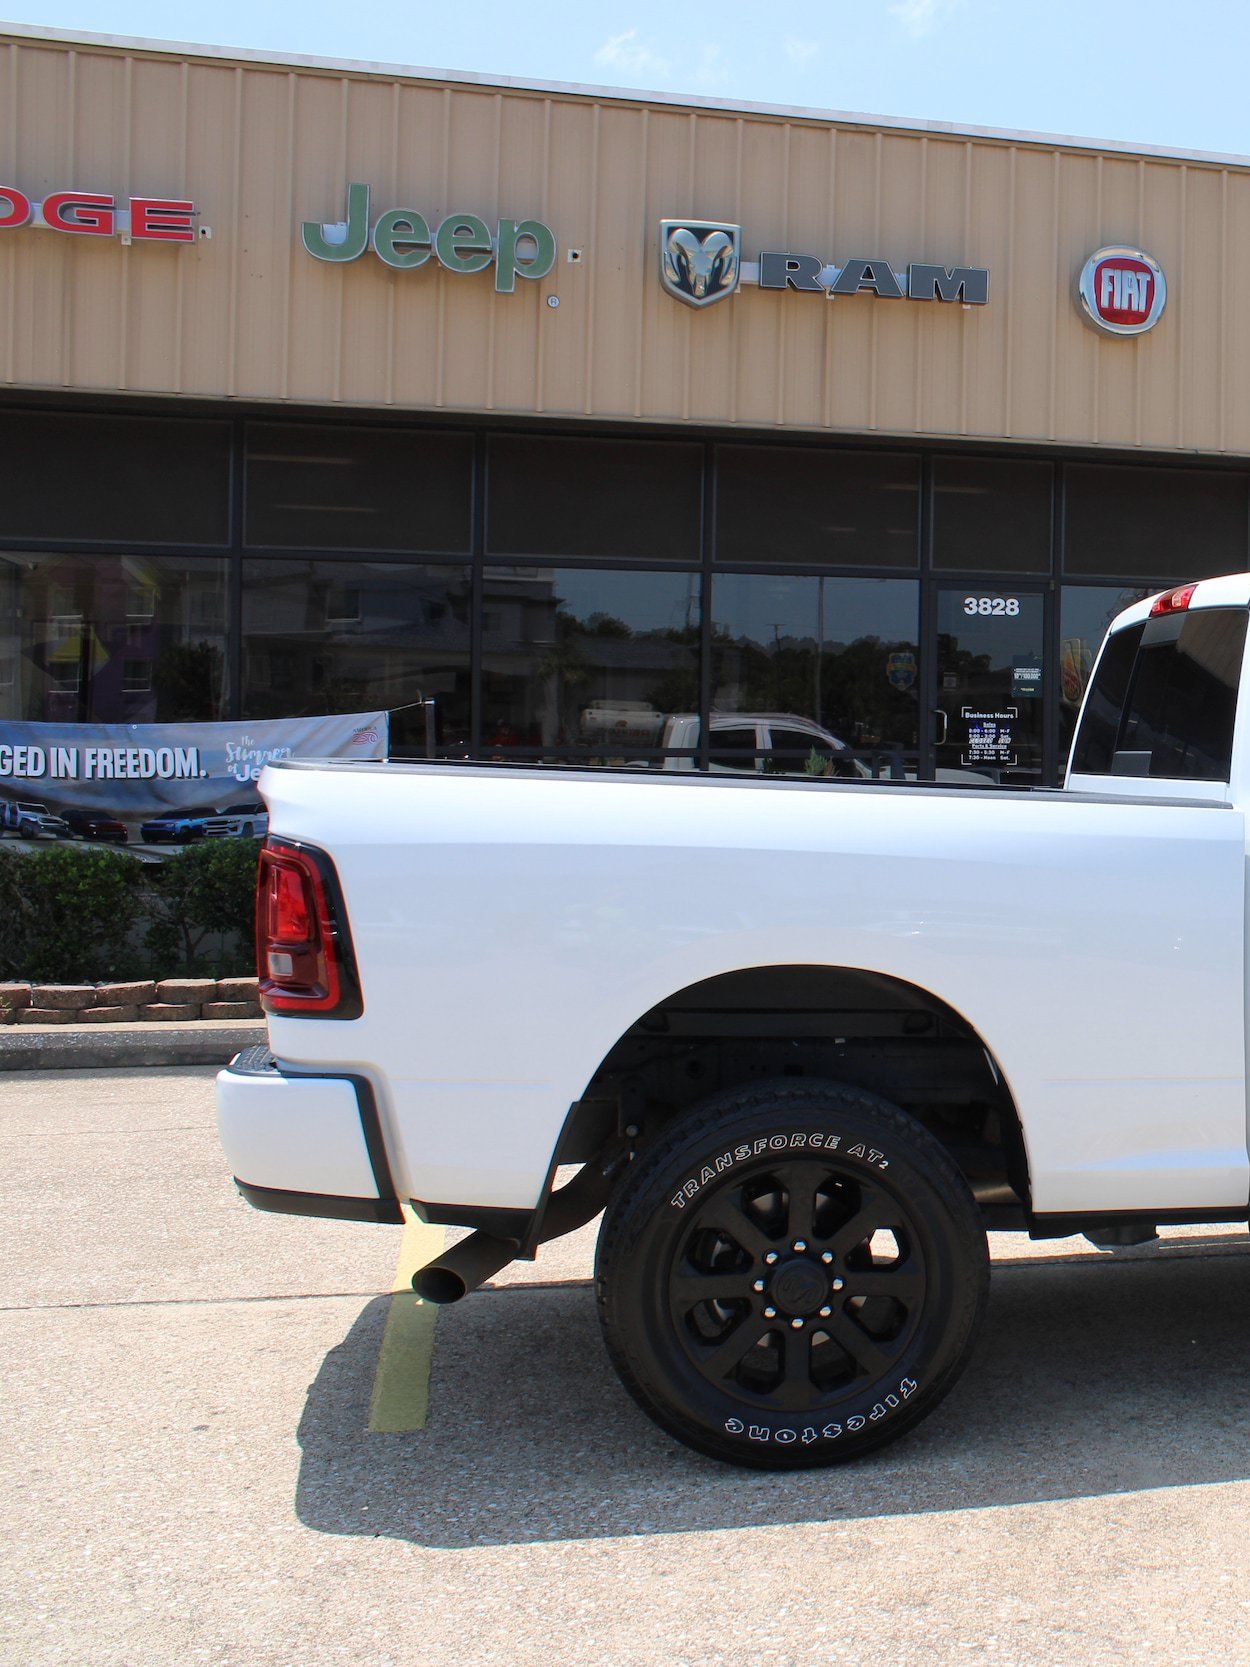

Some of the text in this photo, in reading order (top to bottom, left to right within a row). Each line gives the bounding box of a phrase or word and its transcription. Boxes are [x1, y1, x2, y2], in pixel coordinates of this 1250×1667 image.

[302, 183, 557, 293] Jeep
[758, 251, 989, 304] RAM
[1101, 267, 1151, 313] FIAT
[964, 597, 1021, 617] 3828
[225, 742, 295, 763] Summer
[241, 736, 255, 747] the
[0, 744, 206, 779] GED IN FREEDOM.
[228, 763, 261, 782] of Je
[672, 1133, 841, 1209] TRANSFORCE
